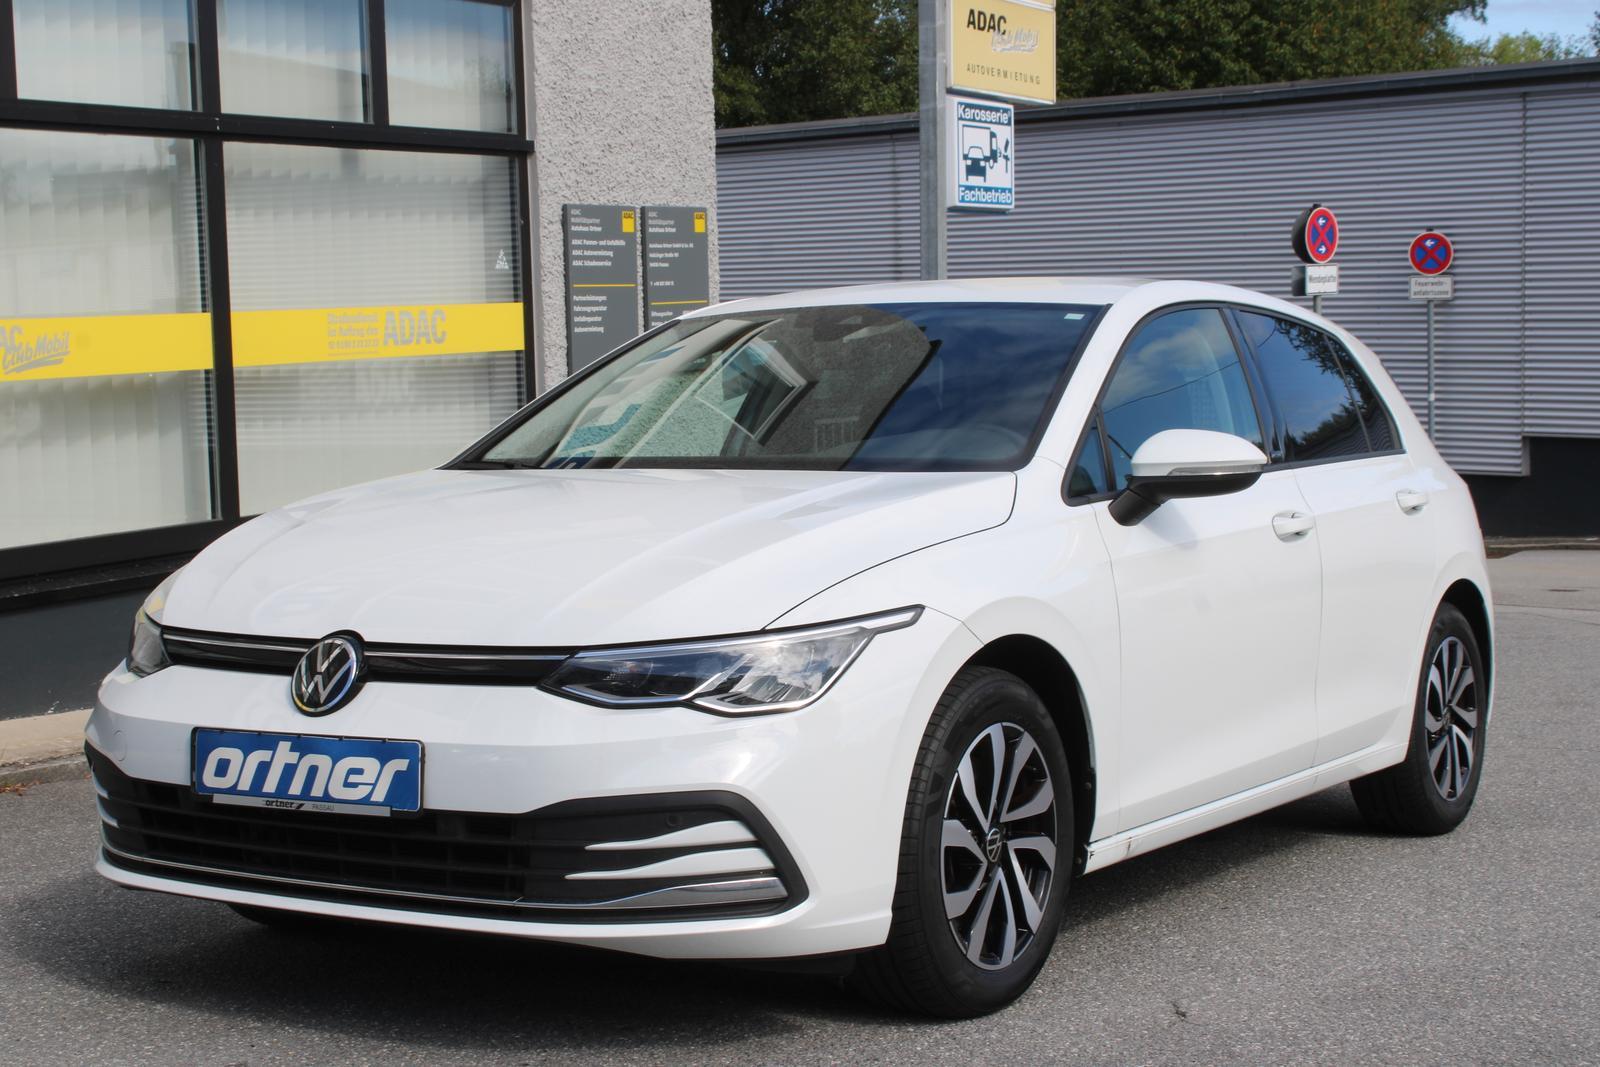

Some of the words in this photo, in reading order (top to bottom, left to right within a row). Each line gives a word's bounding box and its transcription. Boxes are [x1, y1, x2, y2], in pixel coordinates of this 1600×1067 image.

[966, 8, 1007, 35] ADAC
[966, 63, 1041, 85] AUTOVERMIETUNG
[958, 104, 1009, 124] Karosserie
[959, 186, 1012, 204] Fachbetrieb
[383, 309, 447, 346] ADAC
[2, 340, 34, 370] Club
[33, 330, 71, 358] Mobil
[202, 741, 410, 802] ortner
[265, 799, 295, 809] ortner
